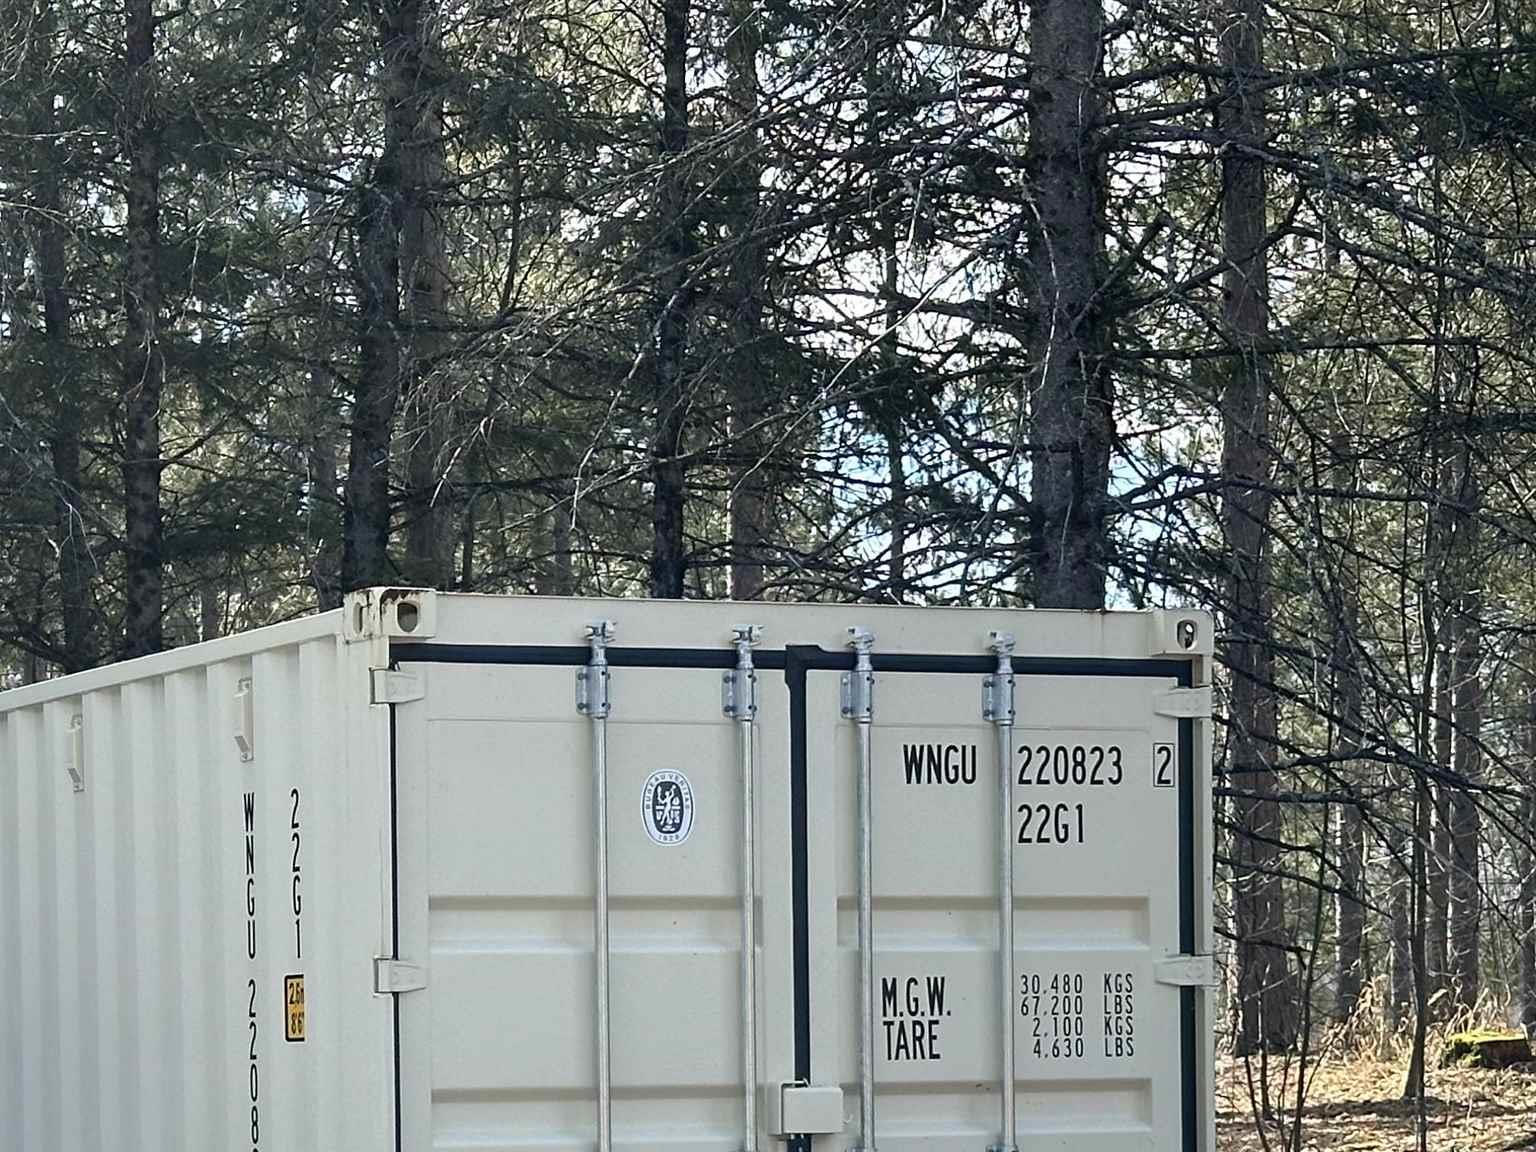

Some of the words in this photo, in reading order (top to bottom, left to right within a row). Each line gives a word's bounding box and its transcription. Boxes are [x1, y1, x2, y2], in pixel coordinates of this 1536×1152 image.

[902, 744, 977, 785] WNGU
[1017, 745, 1123, 785] 220823
[1156, 745, 1172, 785] 2
[1017, 803, 1084, 844] 22G1
[243, 791, 257, 960] WNGU
[290, 788, 302, 960] 22G1
[882, 976, 952, 1018] M.G.W.
[1020, 974, 1084, 995] 30.480
[1103, 973, 1134, 994] KGS
[1020, 995, 1084, 1017] 67.200
[1103, 994, 1134, 1015] LBS
[882, 1019, 942, 1061] TARE
[1032, 1016, 1084, 1038] 2.100
[1103, 1015, 1134, 1037] KGS
[1032, 1038, 1085, 1059] 4.630
[1104, 1037, 1135, 1058] LBS
